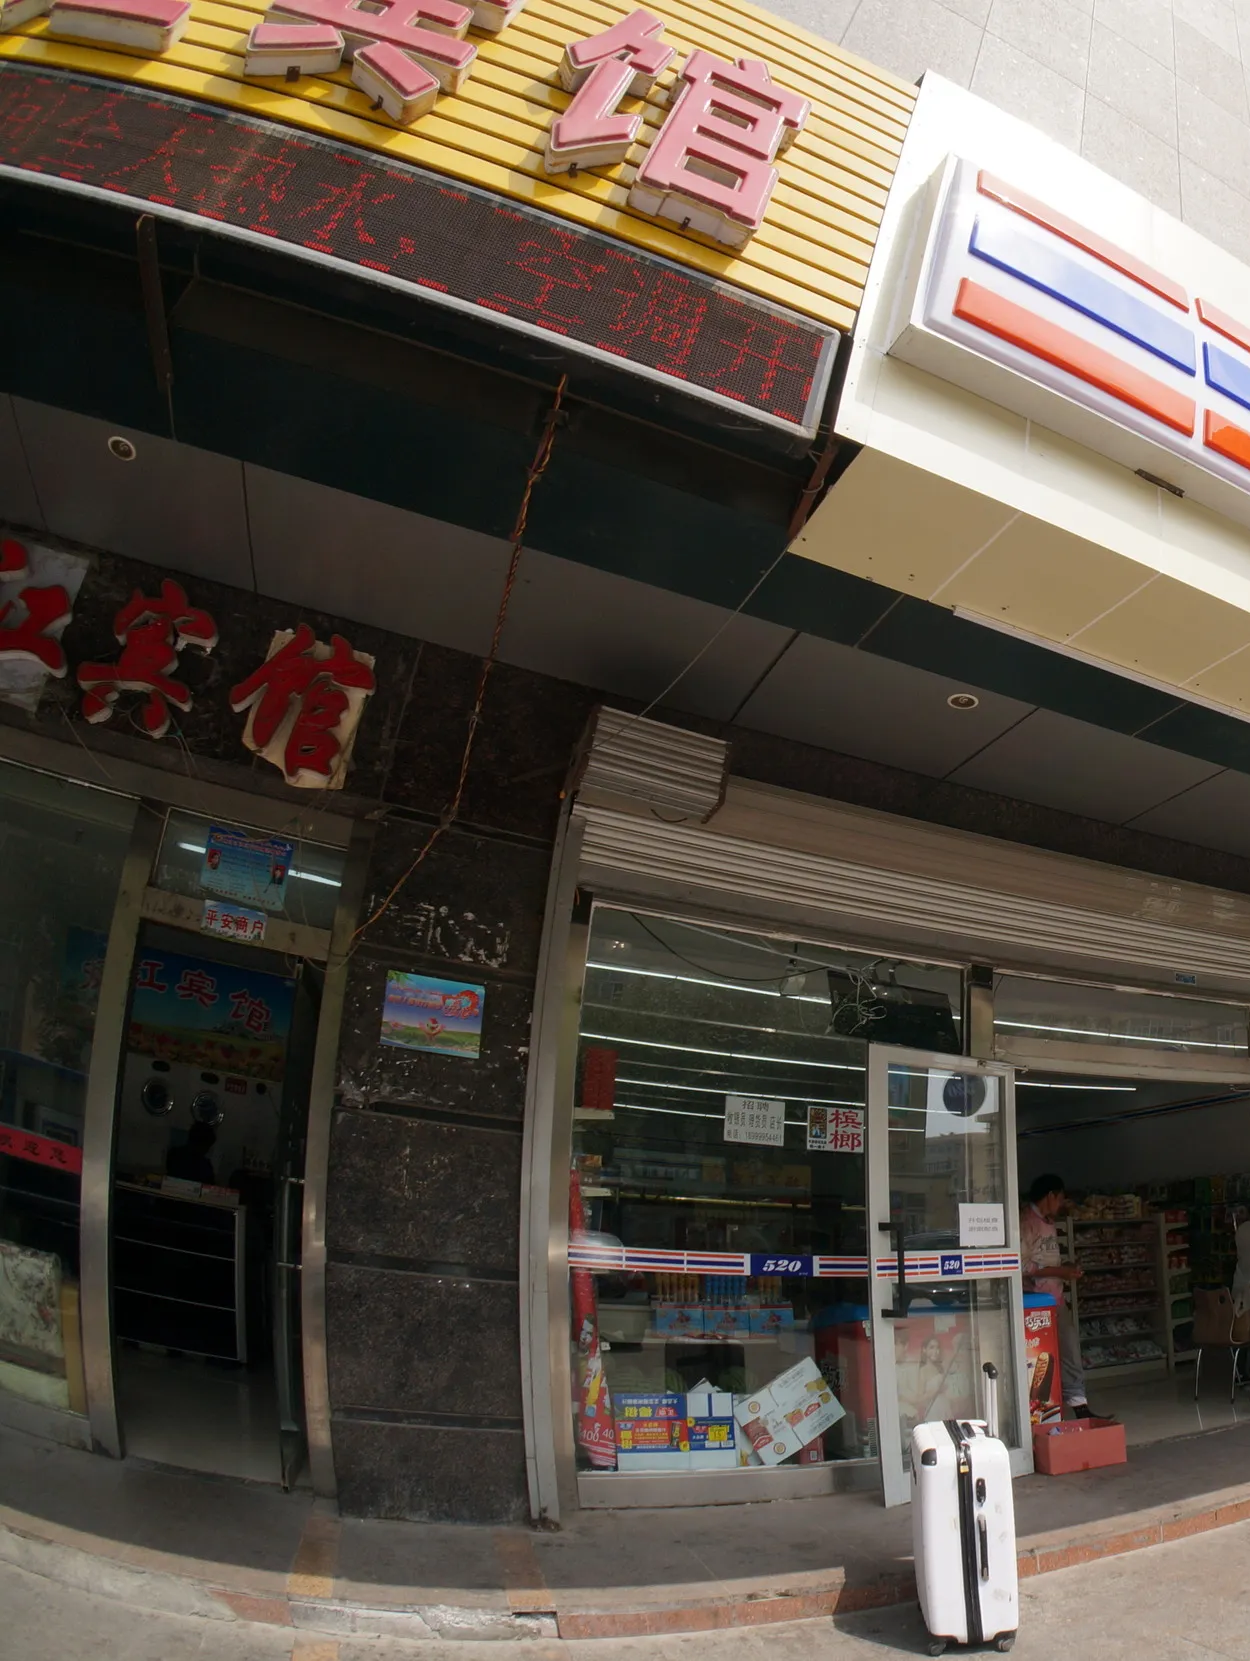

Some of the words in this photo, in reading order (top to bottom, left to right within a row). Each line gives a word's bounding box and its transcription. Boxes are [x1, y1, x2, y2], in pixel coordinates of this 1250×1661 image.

[205, 908, 265, 936] 平安商户
[741, 1100, 769, 1112] 招聘
[828, 1109, 863, 1152] 槟榔
[762, 1259, 802, 1273] 520
[943, 1259, 960, 1270] 520
